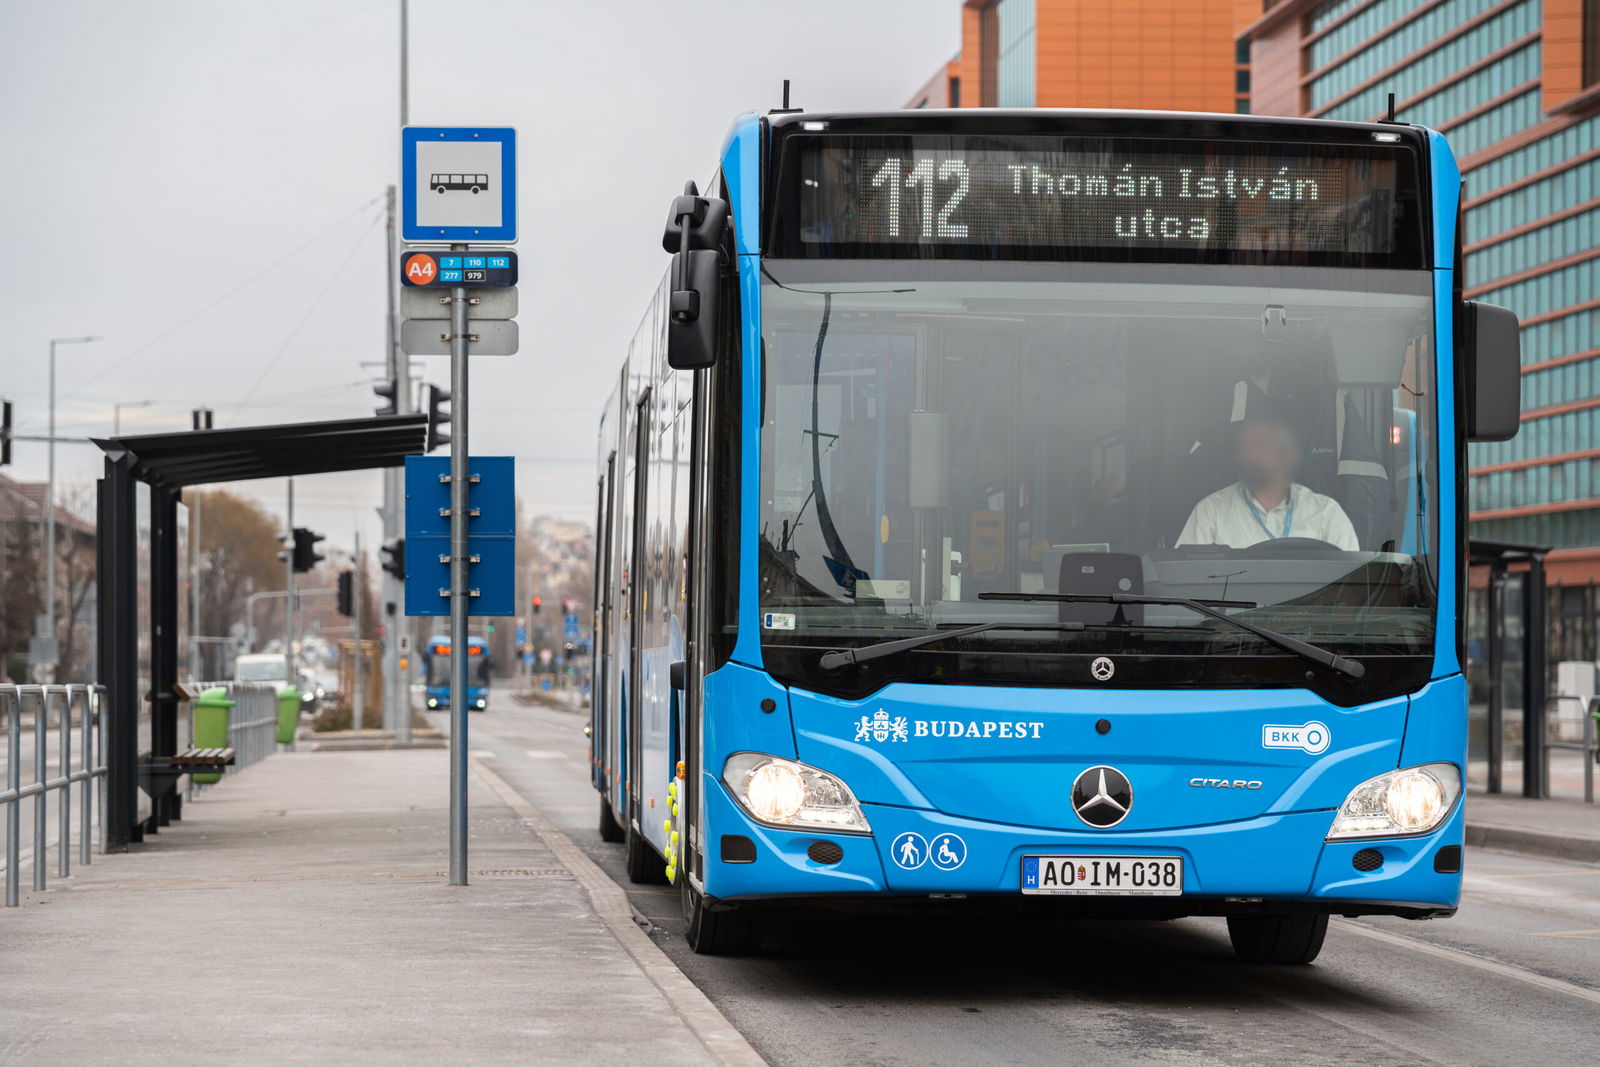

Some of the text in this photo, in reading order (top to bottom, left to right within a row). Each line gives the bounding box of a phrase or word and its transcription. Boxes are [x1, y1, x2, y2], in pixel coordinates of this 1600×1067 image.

[1008, 163, 1318, 200] Thomán István
[872, 158, 970, 237] 112
[1115, 208, 1209, 238] utca
[408, 262, 433, 277] A4
[914, 720, 1044, 739] BUDAPEST
[1271, 731, 1300, 742] BKK
[1189, 777, 1263, 790] CITARO
[1027, 875, 1035, 885] H
[1043, 861, 1176, 887] AO IM-038
